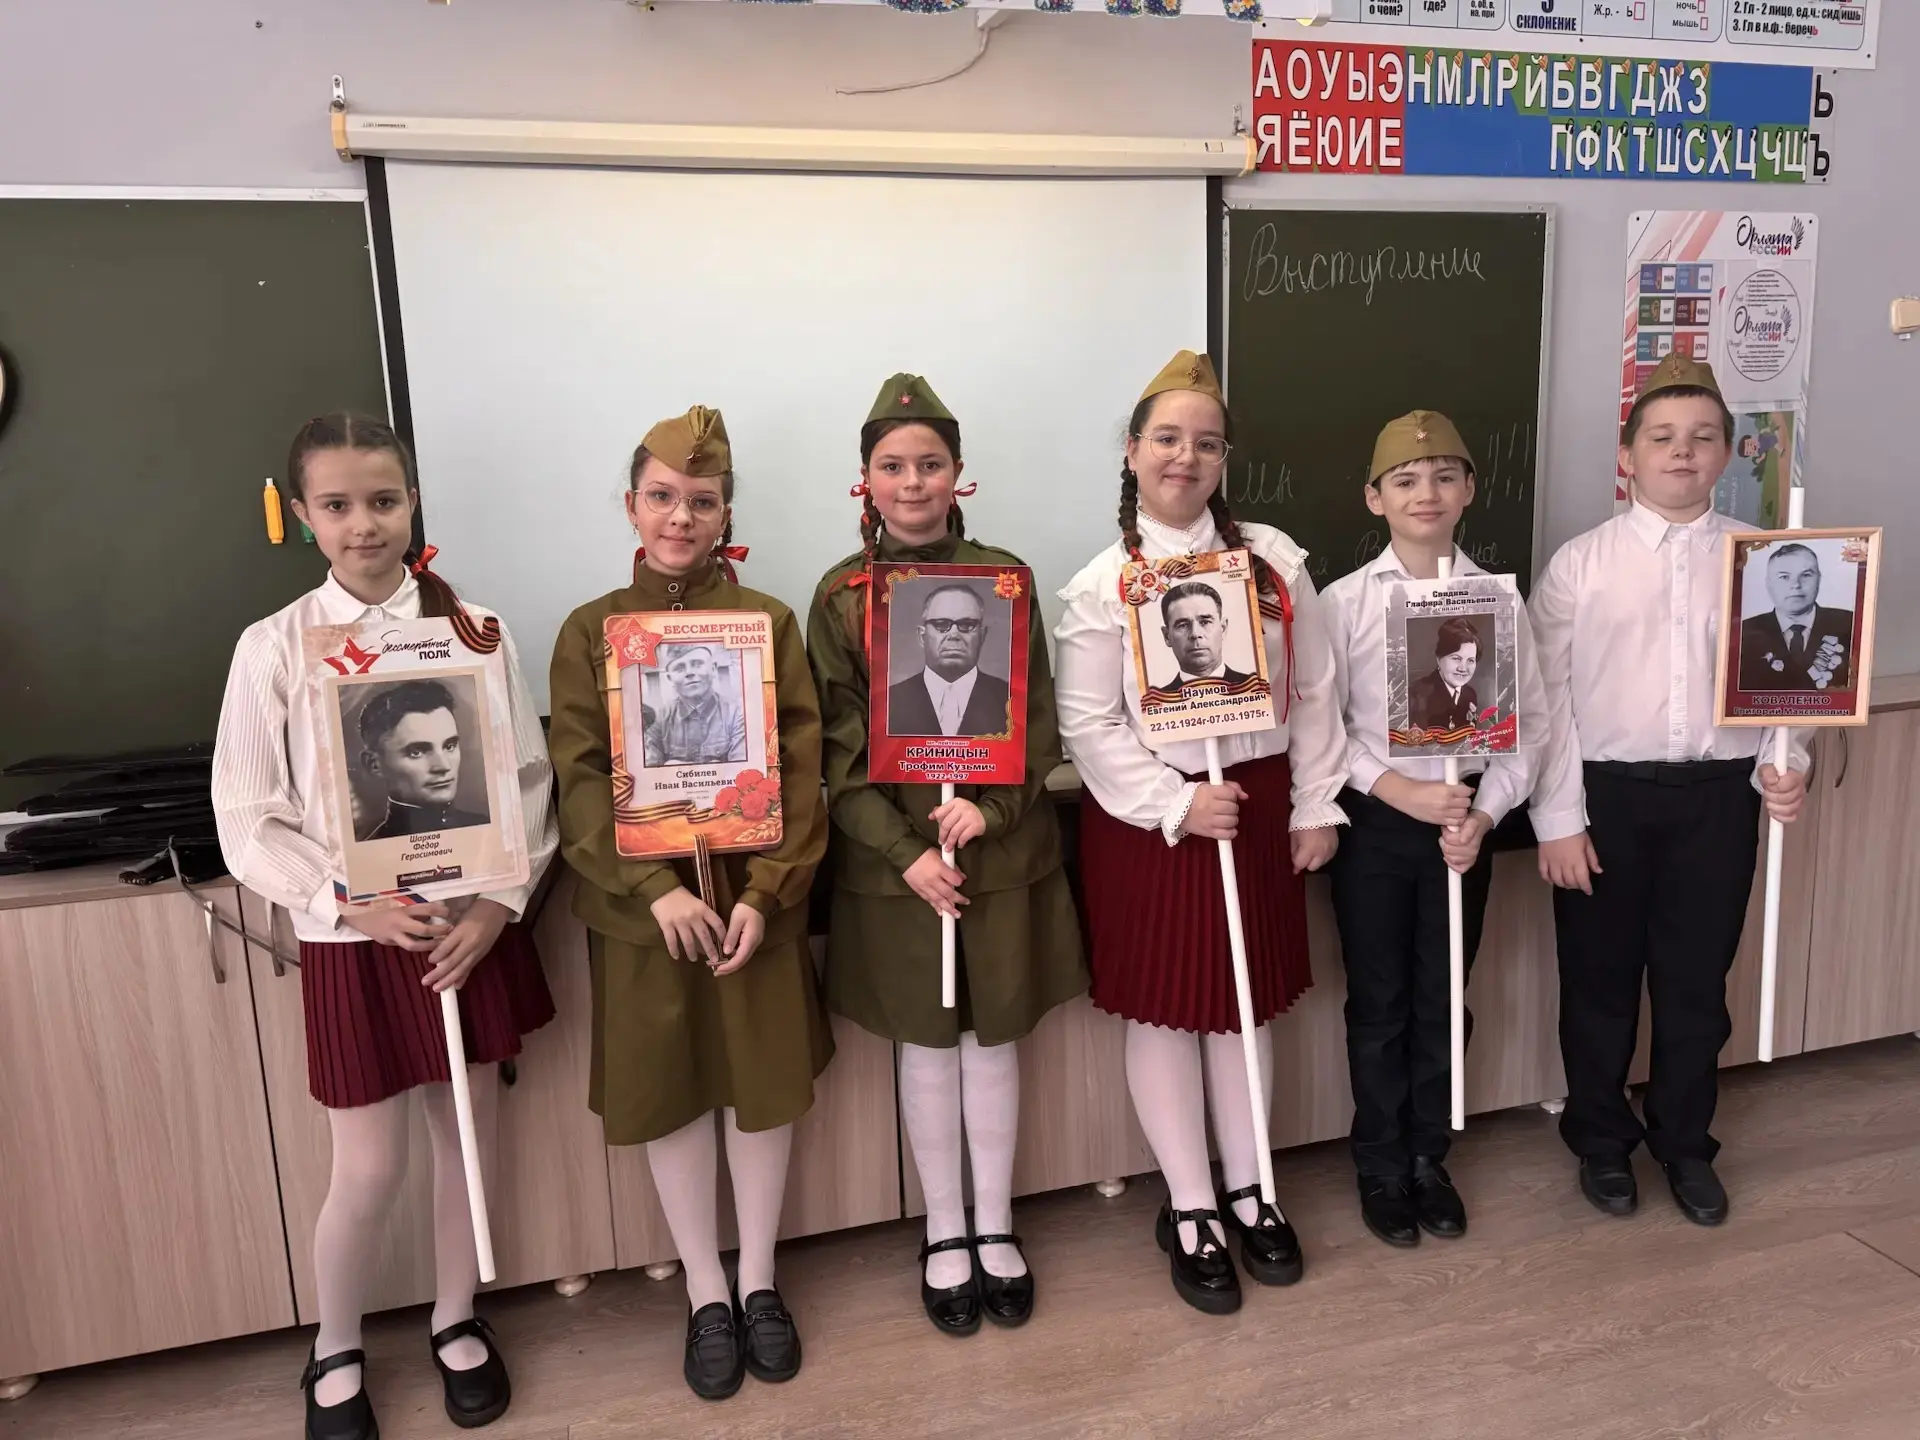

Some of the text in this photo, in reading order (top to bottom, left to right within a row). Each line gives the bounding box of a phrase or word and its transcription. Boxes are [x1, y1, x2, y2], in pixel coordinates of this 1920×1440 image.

[1377, 5, 1403, 16] чем?
[1423, 0, 1447, 12] где?
[1593, 4, 1613, 18] Ж.р.
[1676, 1, 1697, 10] ночь
[1734, 1, 1742, 14] 2.
[1743, 2, 1755, 15] Гл
[1761, 3, 1767, 15] 2
[1768, 4, 1795, 18] лицо,
[1516, 14, 1577, 31] СКЛОНЕНИЕ
[1672, 19, 1699, 28] мышь
[1733, 19, 1741, 32] 3.
[1742, 20, 1754, 32] Гл
[1785, 22, 1818, 36] беречь
[1736, 215, 1793, 250] Орлята
[1243, 222, 1486, 306] Выступление
[1733, 305, 1783, 337] Орлята
[1406, 597, 1497, 608] Глафира Васильевна
[663, 620, 766, 634] БЕССМЕРТНЫЙ
[730, 634, 767, 645] ПОЛК
[419, 649, 451, 660] ПОЛК
[1183, 685, 1228, 698] Наумов
[1147, 693, 1267, 716] Евгений Александрович
[1752, 695, 1831, 705] КОВАЛЕНКО
[1783, 707, 1849, 716] Максимович
[907, 747, 988, 760] КРИНИЦЫН
[899, 761, 995, 772] Трофим Кузьмич
[675, 769, 717, 779] Сибилев
[655, 782, 680, 790] Иван
[413, 842, 439, 851] Федор
[401, 848, 453, 861] Герасимович
